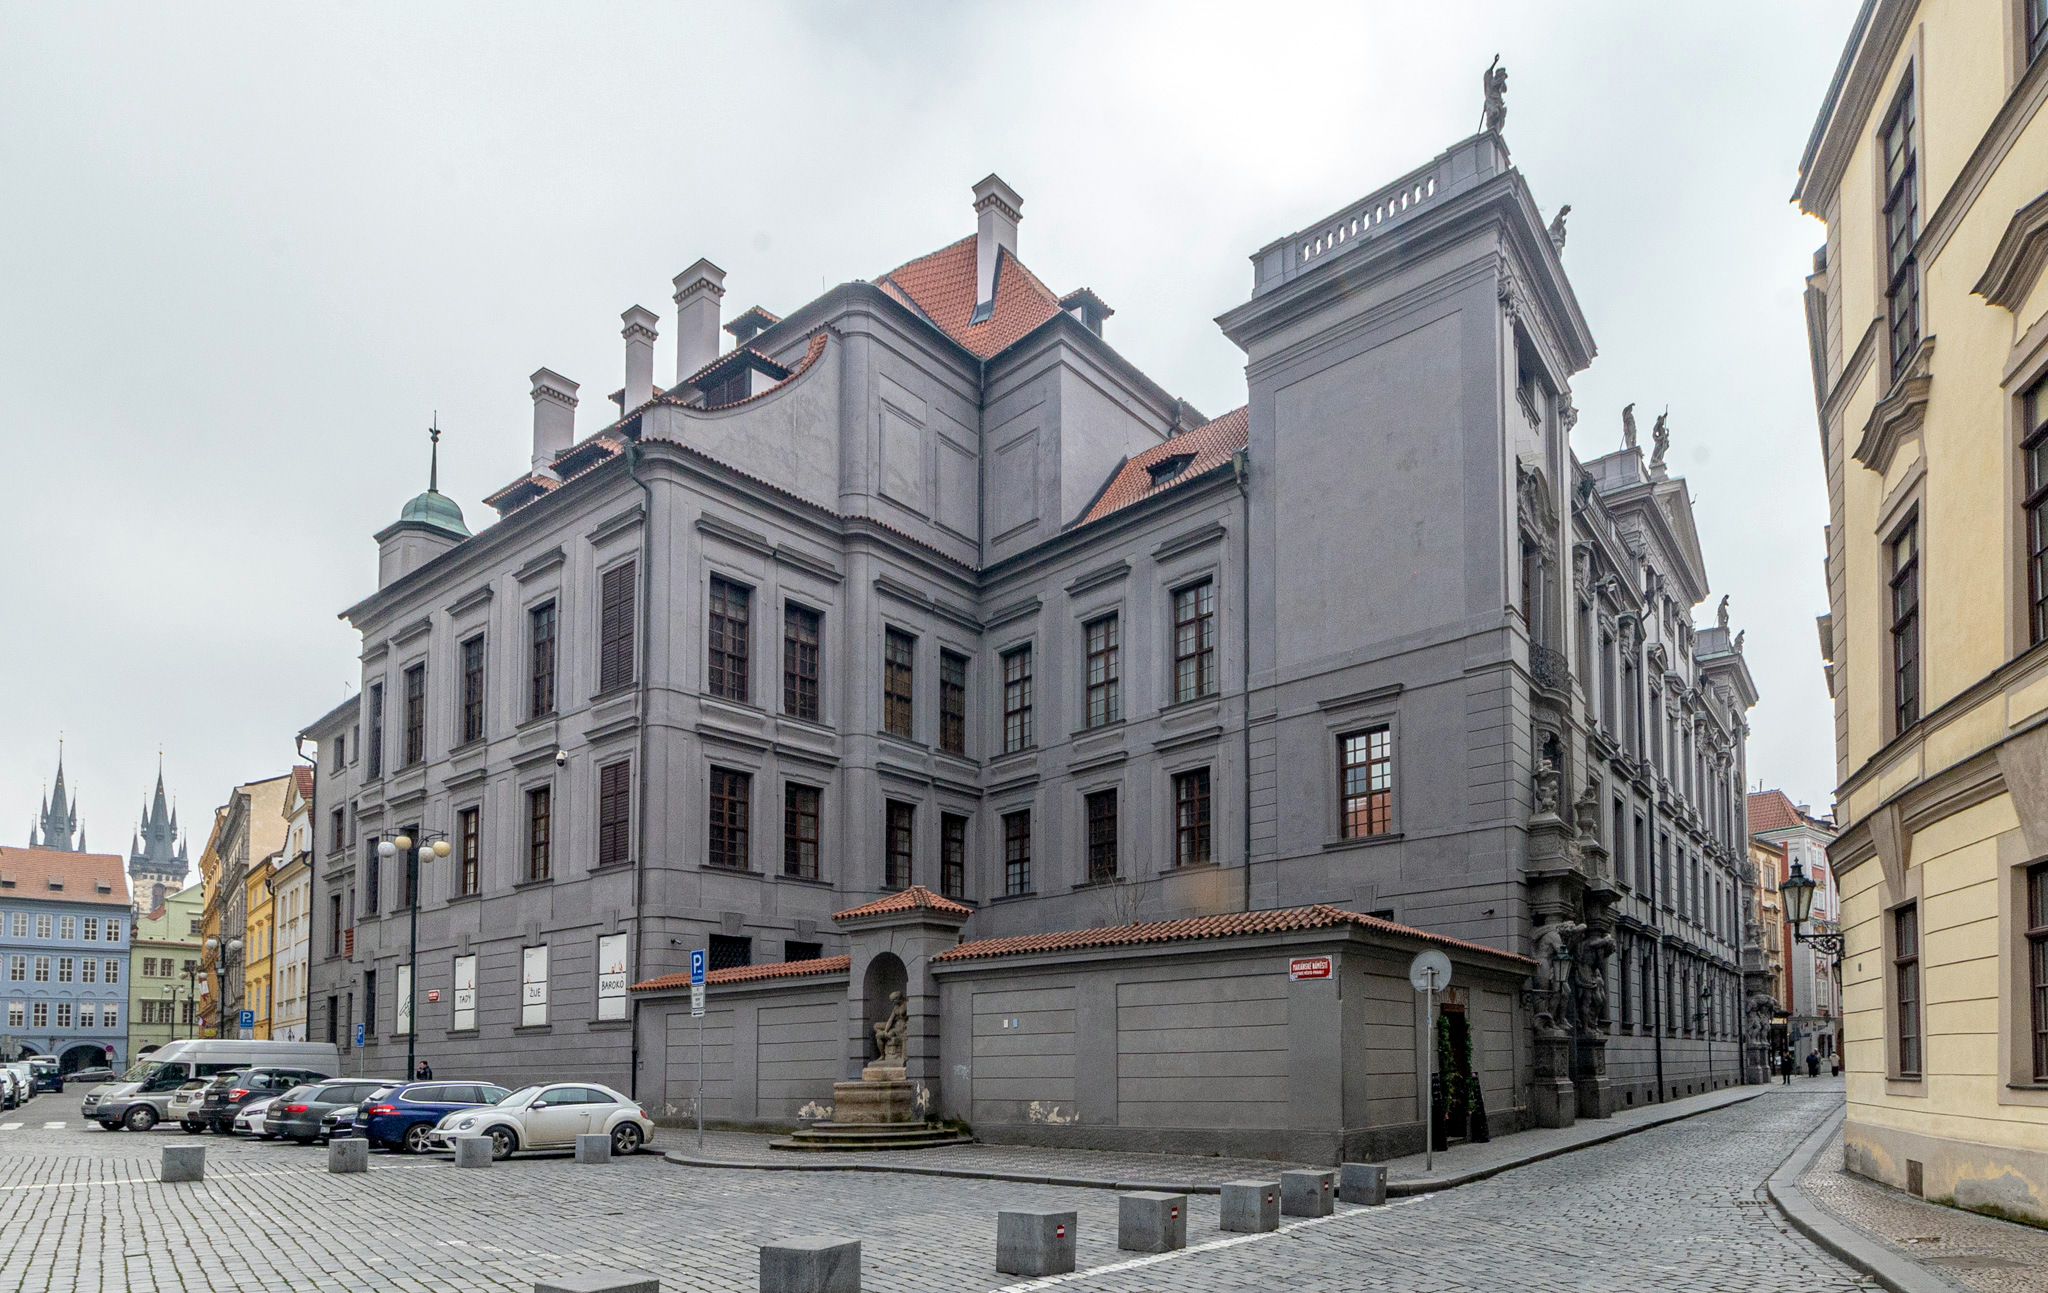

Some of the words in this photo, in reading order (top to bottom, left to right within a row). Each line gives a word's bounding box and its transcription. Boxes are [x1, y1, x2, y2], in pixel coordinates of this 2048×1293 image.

[693, 954, 702, 974] P
[601, 980, 625, 991] BAROKO
[459, 994, 471, 1004] TADY
[242, 1012, 252, 1023] P
